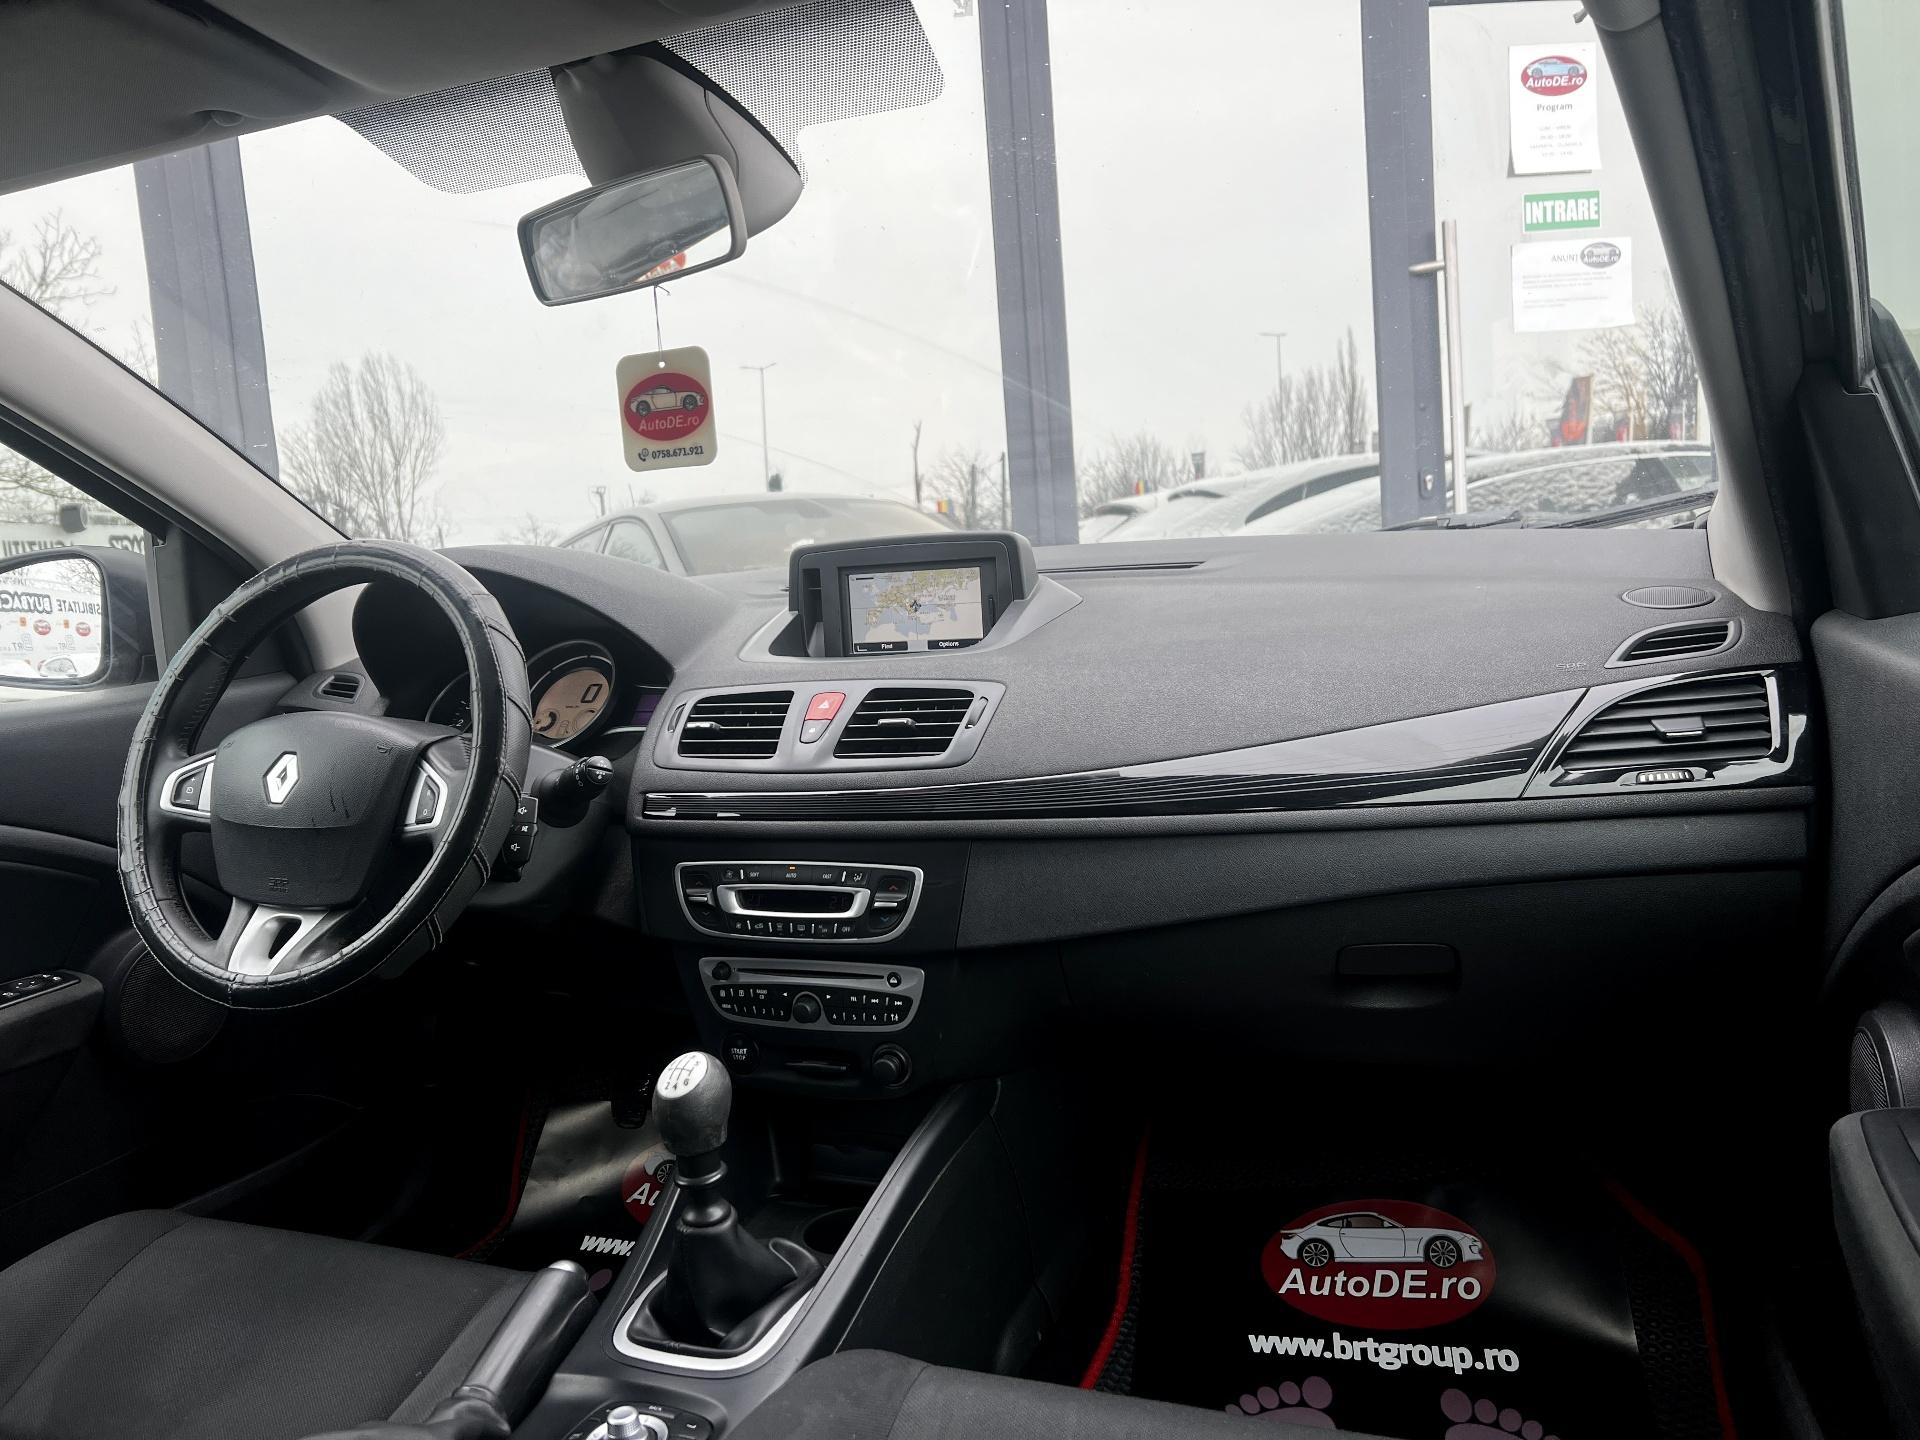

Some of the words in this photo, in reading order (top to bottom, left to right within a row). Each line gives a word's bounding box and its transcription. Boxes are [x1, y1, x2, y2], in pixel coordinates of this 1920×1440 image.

[1525, 75, 1584, 89] AutoDE.ro
[1536, 103, 1573, 113] Program
[1525, 197, 1599, 225] INTRARE
[638, 415, 700, 431] AutoDE.ro
[651, 445, 704, 460] 0758.671.921
[580, 683, 603, 703] 0
[731, 1047, 748, 1055] START
[1278, 1267, 1482, 1300] AutoDE.ro
[1248, 1331, 1520, 1375] www.brtgroup.ro
